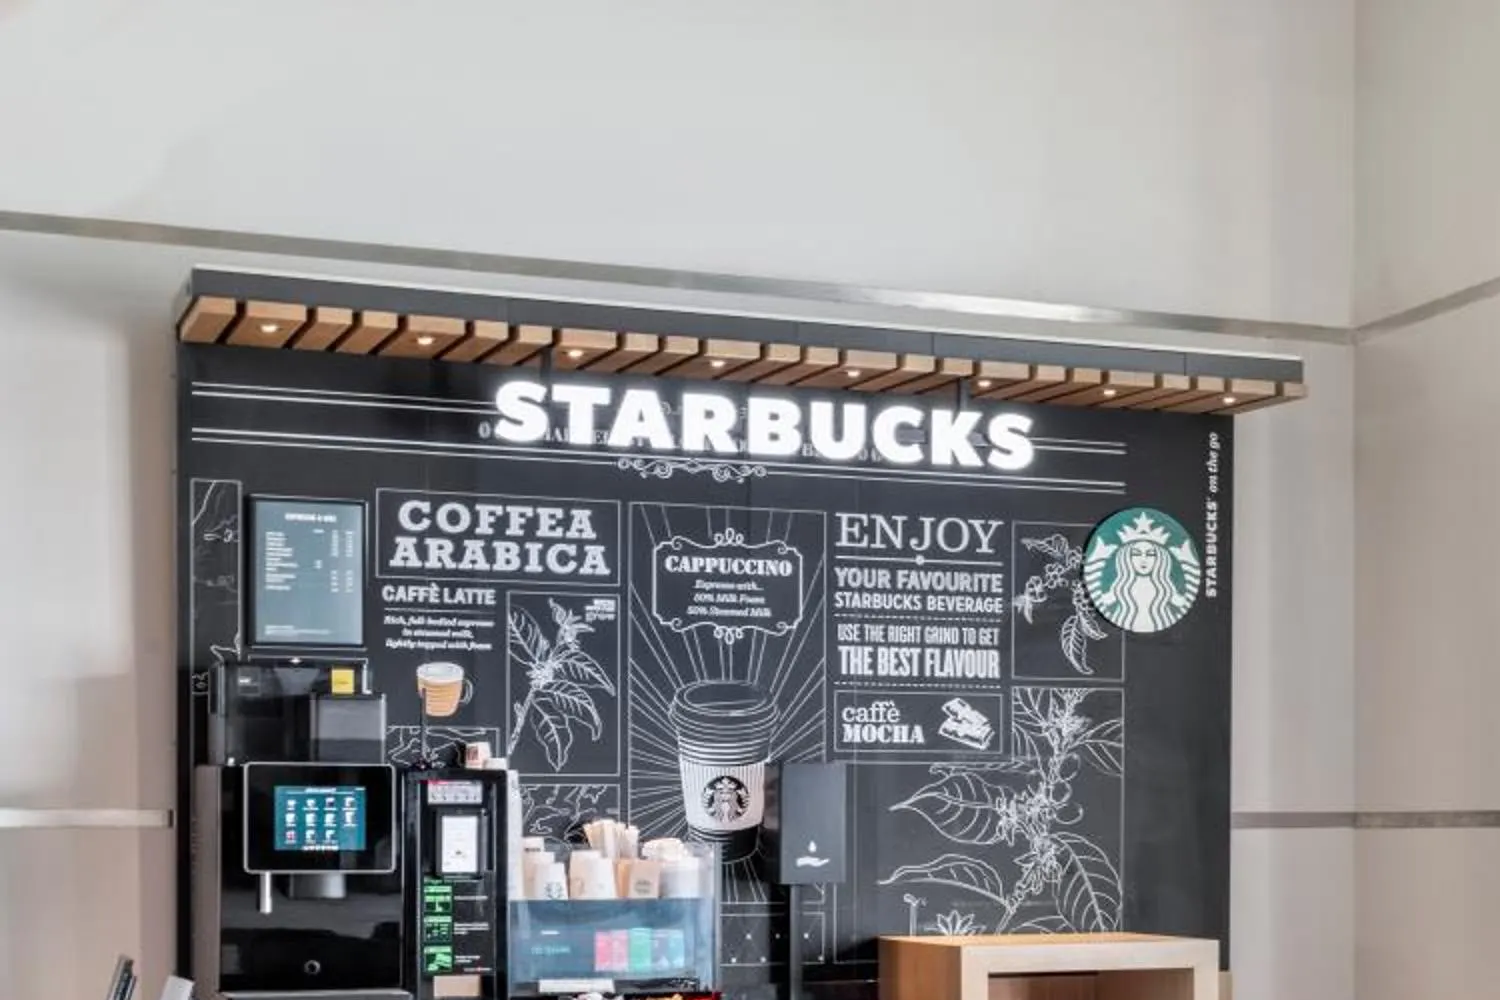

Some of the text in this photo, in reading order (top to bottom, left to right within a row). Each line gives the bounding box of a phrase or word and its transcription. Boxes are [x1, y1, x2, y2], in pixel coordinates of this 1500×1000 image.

[495, 380, 1034, 470] STARBUCKS
[398, 500, 597, 539] COFFEA
[1205, 432, 1221, 598] STARBUCKS on the go
[835, 512, 1004, 553] ENJOY
[389, 536, 611, 575] ARABICA
[665, 555, 793, 576] CAPPUCCINO
[834, 567, 1003, 593] YOUR FAVOURITE
[382, 582, 496, 605] CAFFÈ LATTE
[834, 591, 1003, 613] STARBUCKS BEVERAGE
[837, 623, 1000, 646] USE THE RIGHT GRIND TO GET
[837, 645, 1001, 679] THE BEST FLAVOUR
[842, 700, 900, 723] caffè
[842, 723, 925, 744] MOCHA
